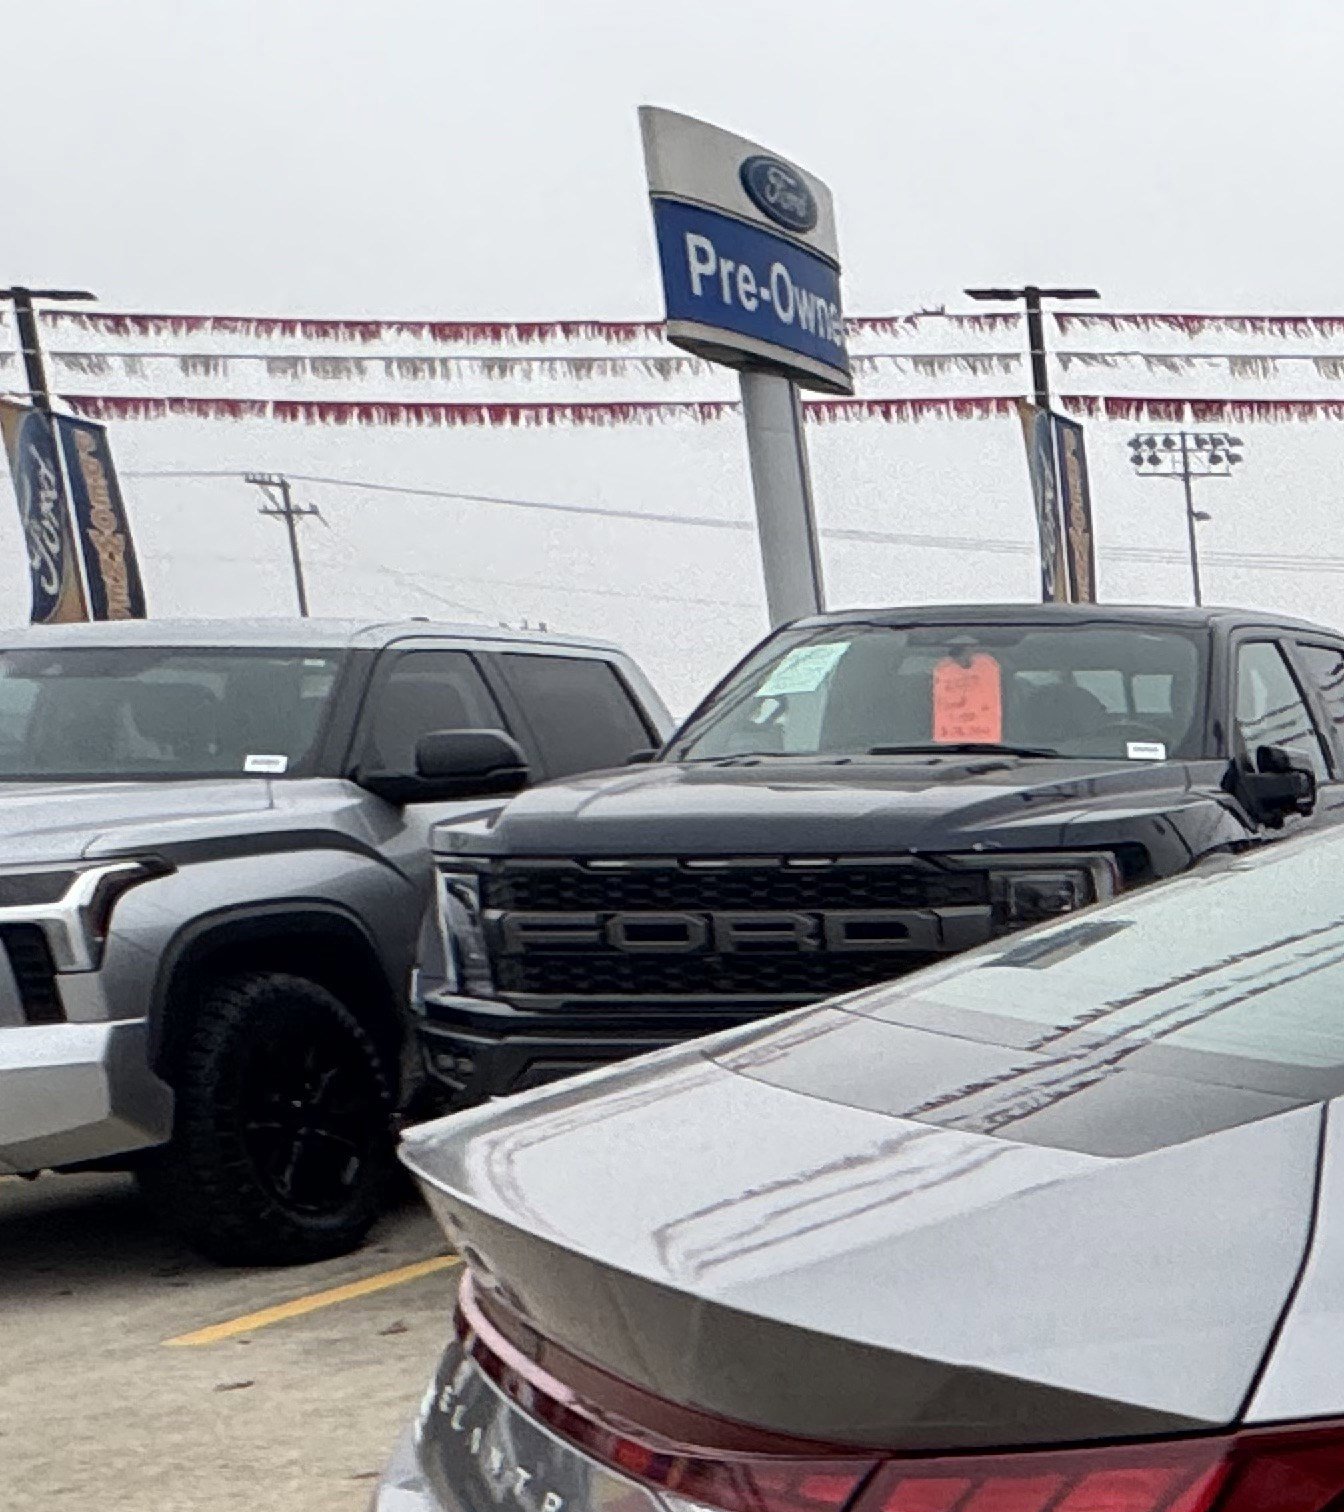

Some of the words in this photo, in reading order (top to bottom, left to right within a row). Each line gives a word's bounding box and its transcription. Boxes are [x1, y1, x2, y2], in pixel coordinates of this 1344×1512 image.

[685, 232, 845, 347] Pre-Owne
[29, 443, 61, 595] Ford
[502, 910, 943, 956] FORD
